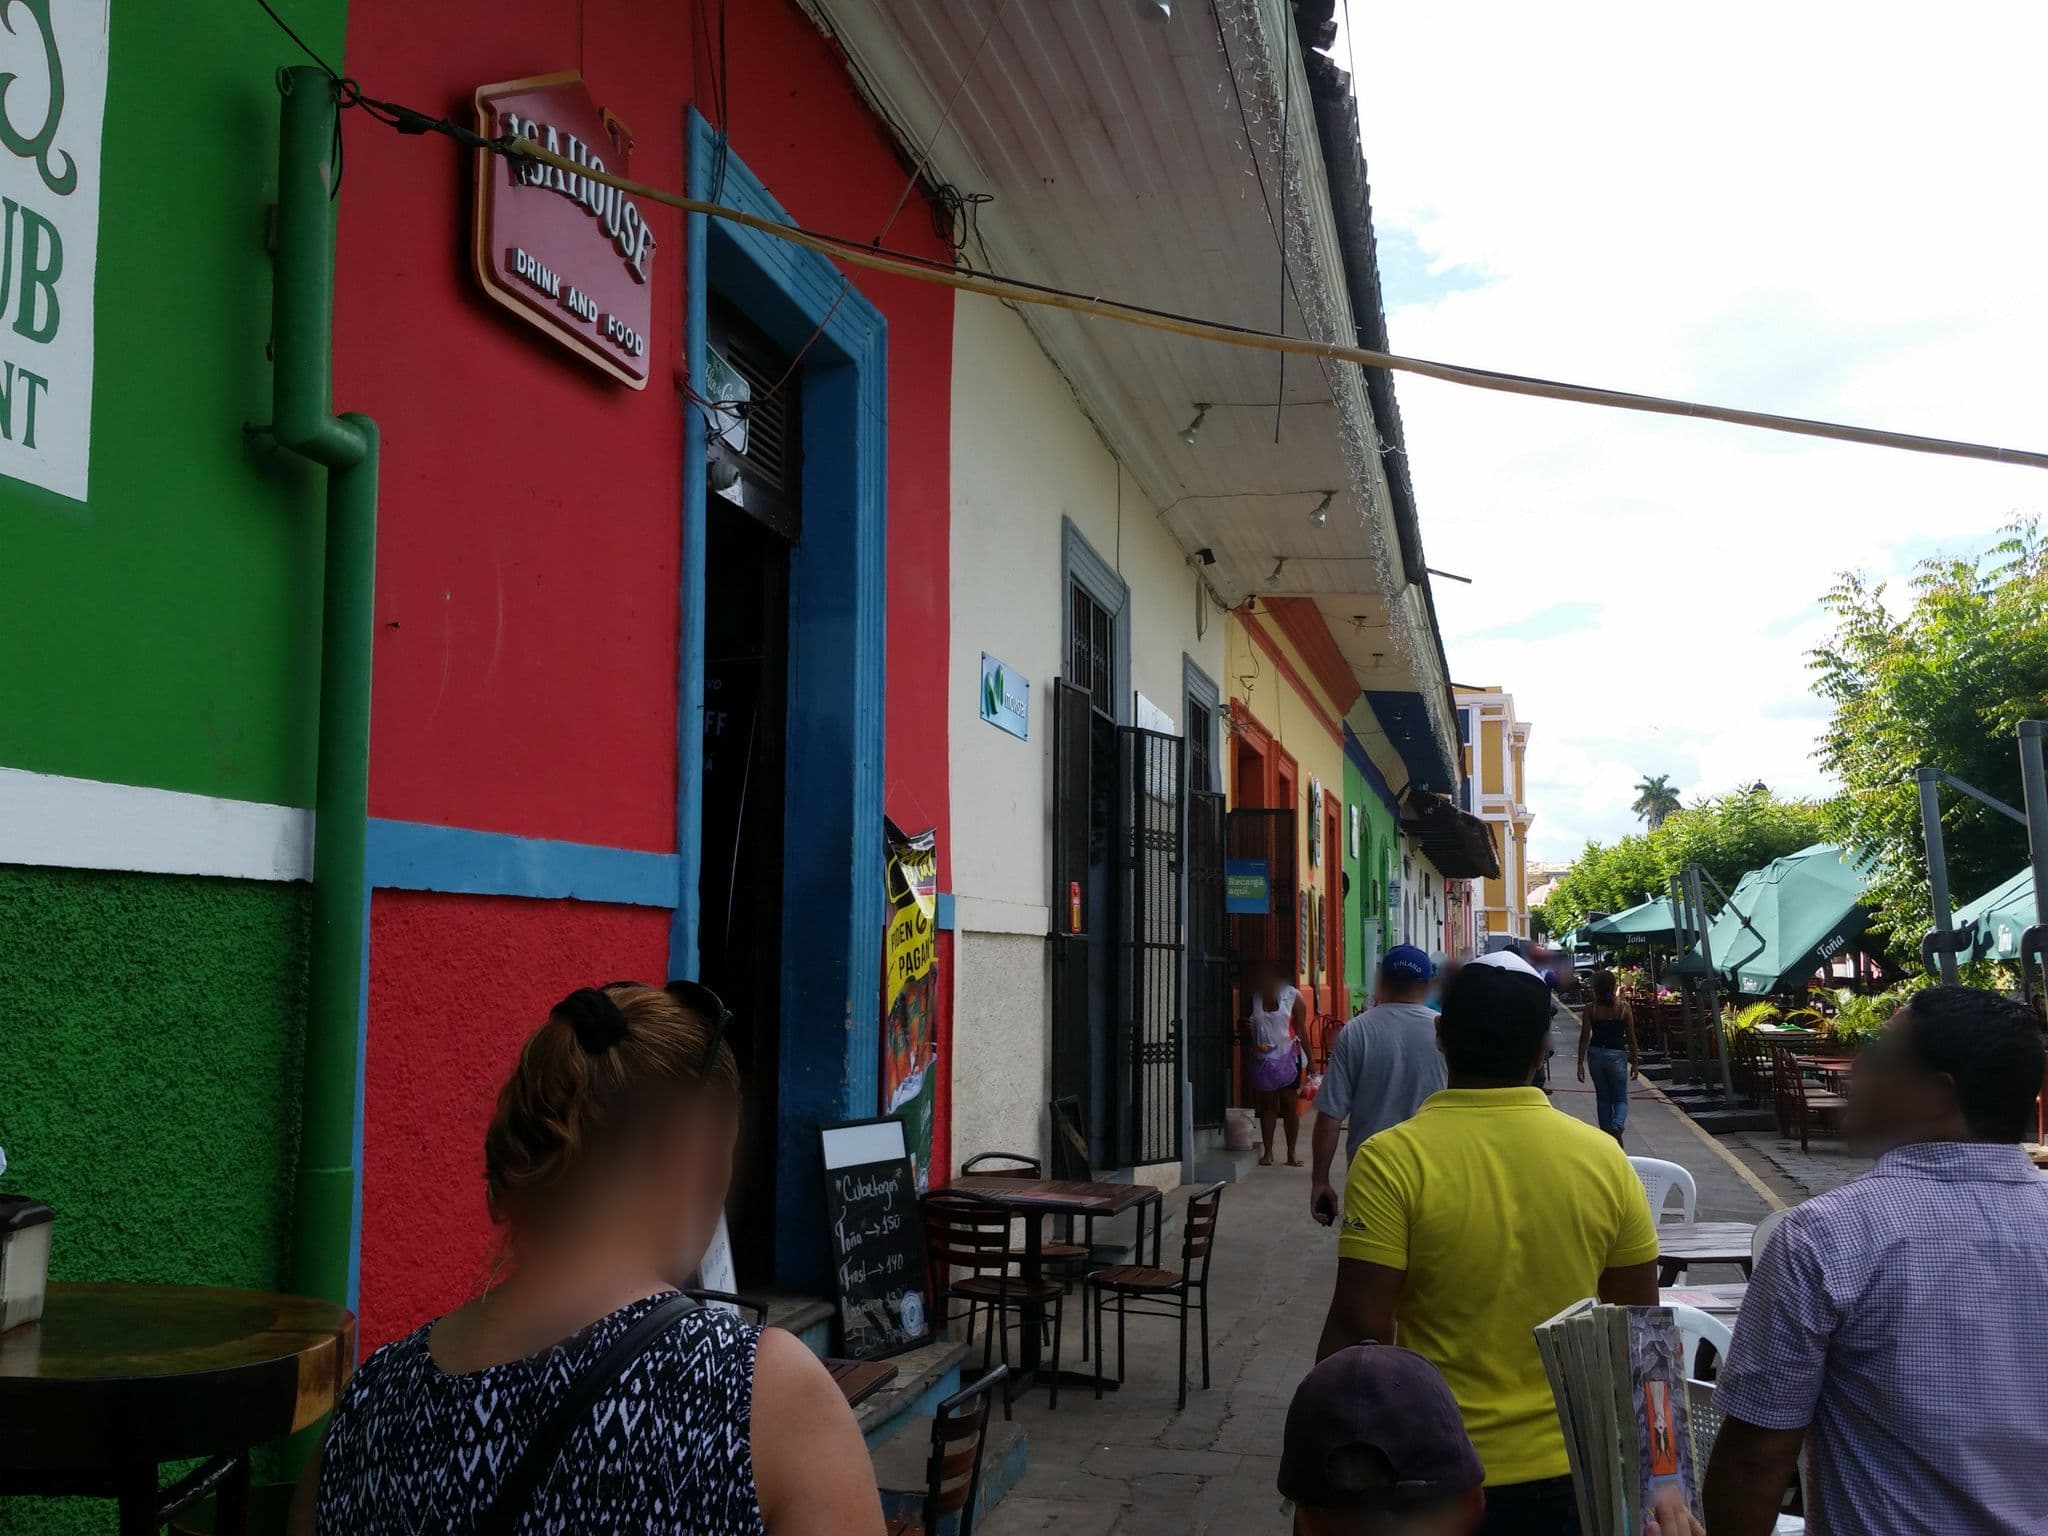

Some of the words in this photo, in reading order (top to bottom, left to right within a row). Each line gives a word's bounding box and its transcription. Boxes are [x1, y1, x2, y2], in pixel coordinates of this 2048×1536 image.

[517, 248, 561, 299] DRINK
[568, 286, 598, 323] AND
[608, 314, 644, 357] FOOD
[891, 919, 913, 953] PIDEN
[1816, 933, 1845, 961] Toña
[898, 943, 930, 979] PAGAN
